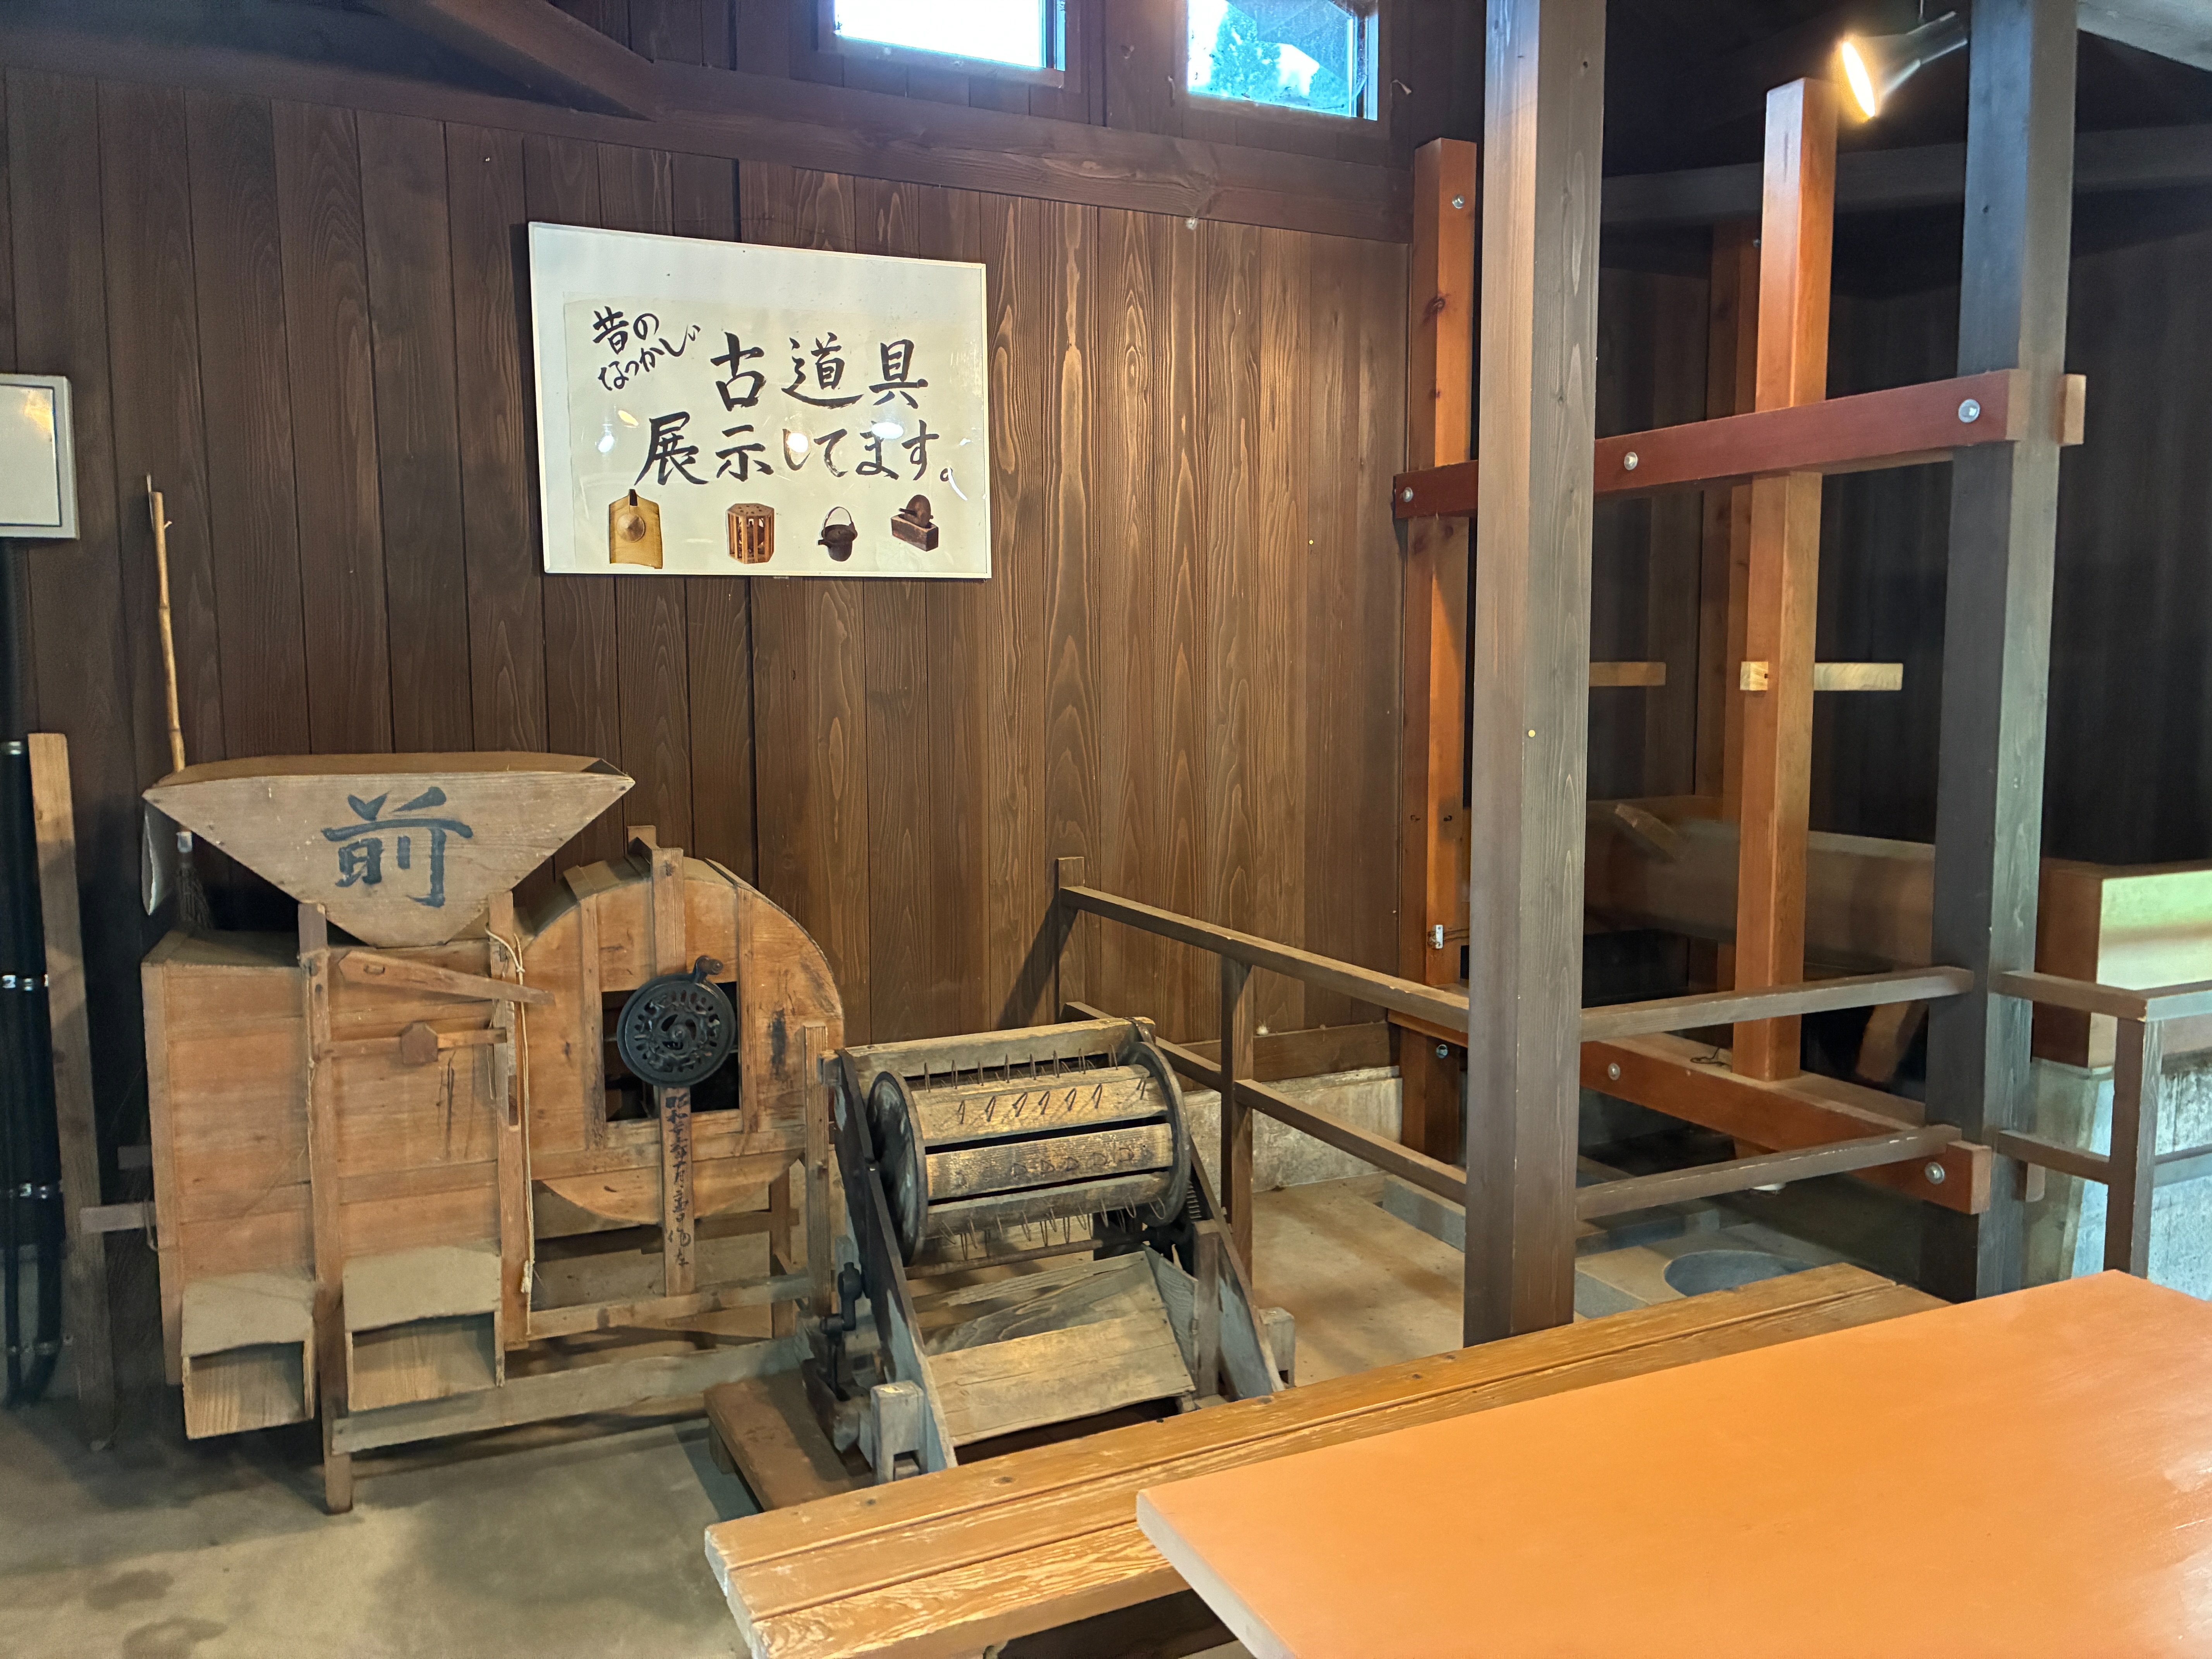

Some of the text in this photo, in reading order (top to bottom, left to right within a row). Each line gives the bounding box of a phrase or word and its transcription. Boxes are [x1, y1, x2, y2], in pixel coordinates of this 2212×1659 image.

[592, 306, 659, 355] 昔の
[598, 324, 701, 391] なつかしい
[710, 331, 928, 412] 古道具
[634, 411, 953, 485] 展示してます。
[321, 786, 474, 908] 前
